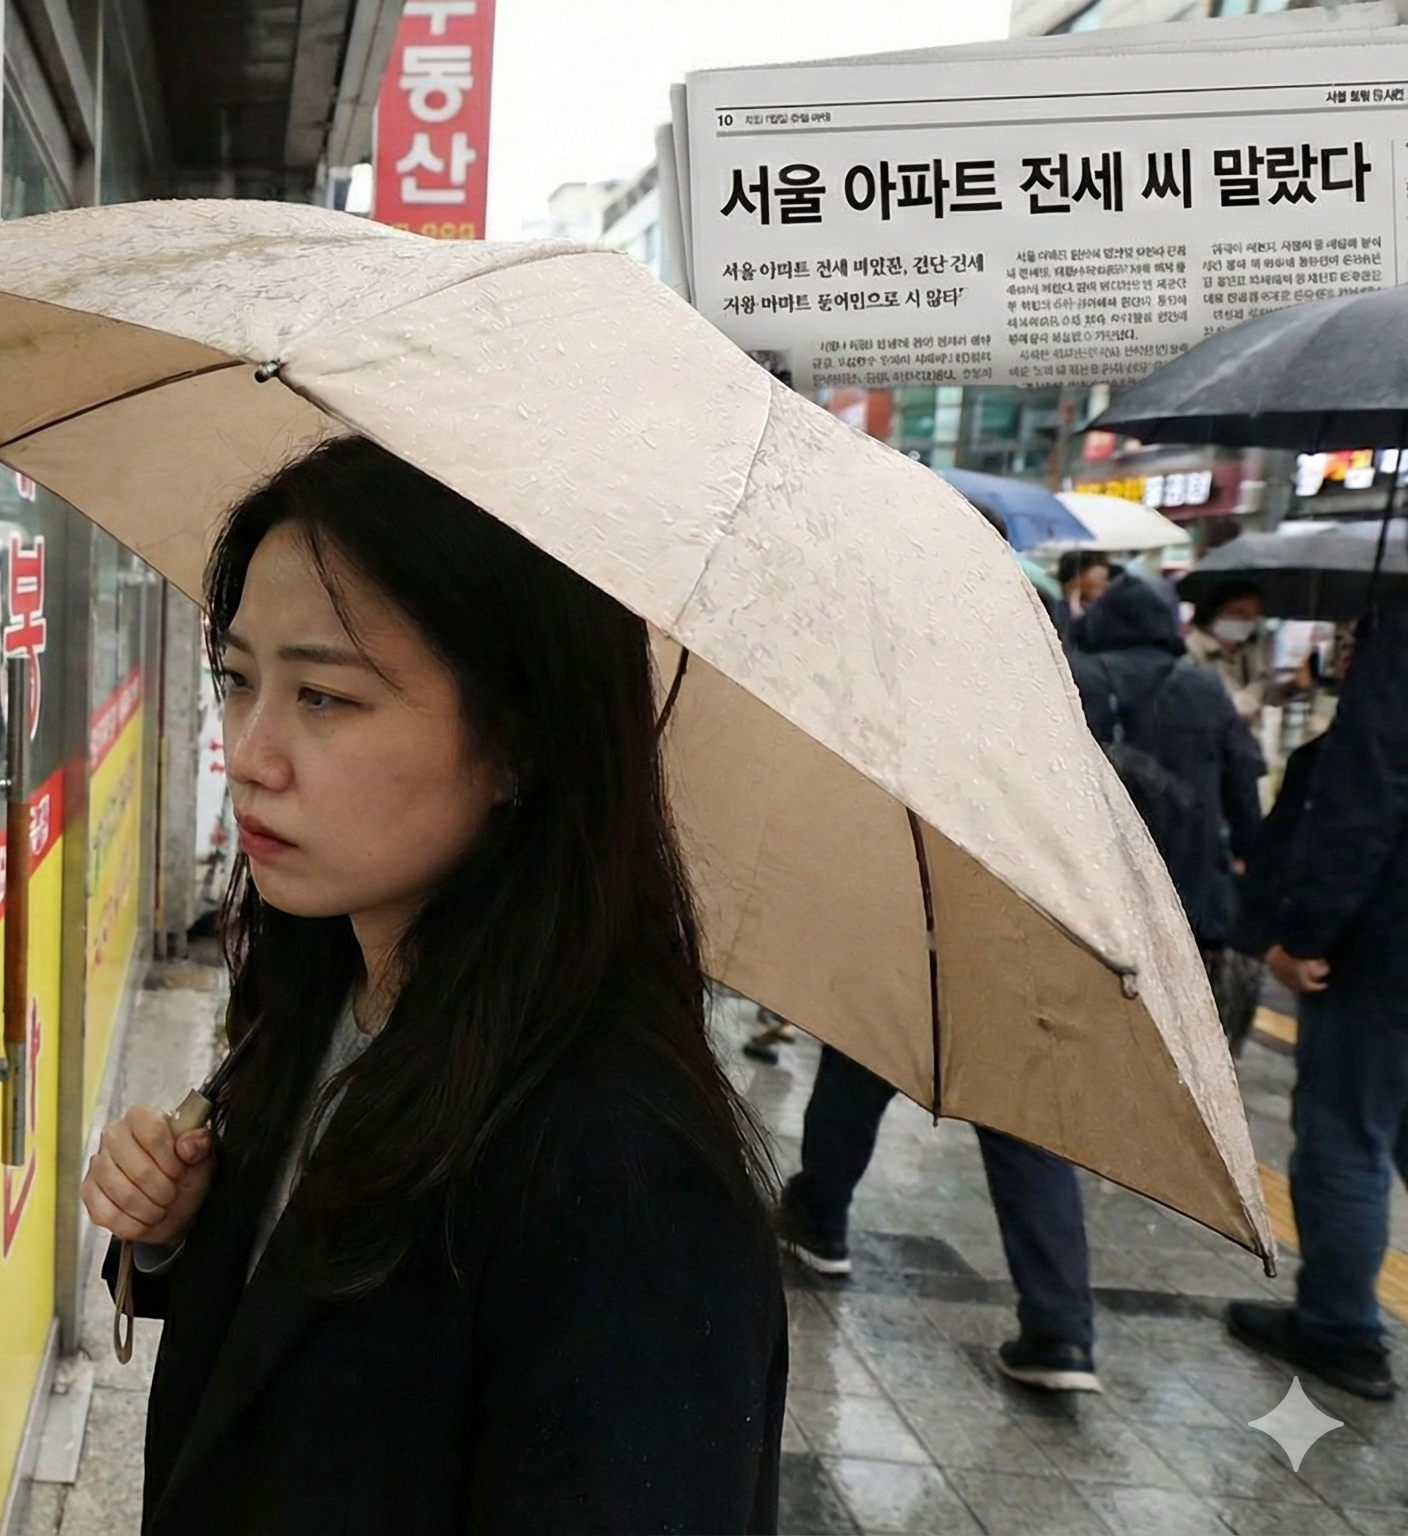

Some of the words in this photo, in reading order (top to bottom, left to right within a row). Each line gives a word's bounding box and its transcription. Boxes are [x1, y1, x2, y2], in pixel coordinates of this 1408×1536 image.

[718, 114, 734, 127] 10
[719, 163, 827, 226] 서울
[844, 158, 1003, 221] 아파트
[1019, 151, 1124, 215] 전세
[1141, 148, 1193, 209] 씨
[1213, 141, 1372, 208] 말랐다
